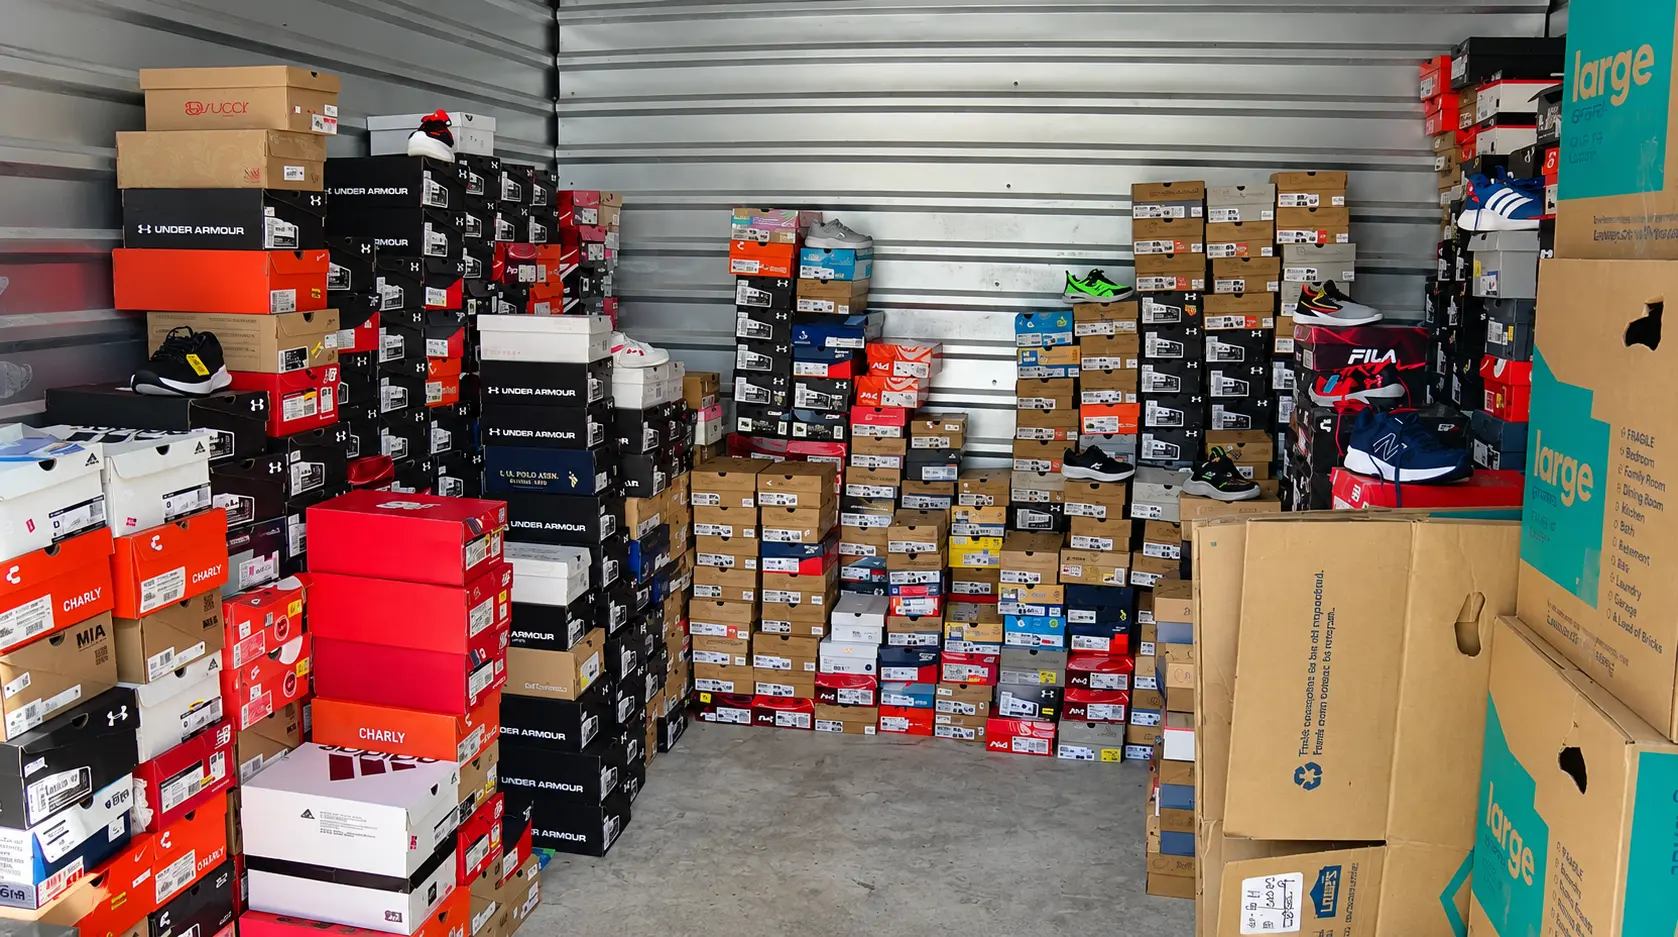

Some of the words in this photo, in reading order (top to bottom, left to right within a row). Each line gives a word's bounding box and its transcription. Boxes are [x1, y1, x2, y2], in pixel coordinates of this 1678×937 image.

[1572, 44, 1654, 106] large
[334, 187, 366, 195] UNDER
[367, 187, 409, 195] ARMOUR
[154, 225, 193, 235] UNDER
[194, 226, 245, 235] ARMOUR
[1348, 348, 1397, 364] FILA
[501, 387, 533, 396] UNDER
[534, 388, 576, 397] ARMOUR
[502, 429, 533, 438] UNDER
[535, 430, 576, 439] ARMOUR
[1627, 429, 1655, 449] FRAGILE
[516, 471, 536, 479] POLO
[1534, 429, 1594, 507] large
[510, 520, 542, 530] UNDER
[544, 522, 586, 532] ARMOUR
[192, 564, 222, 584] CHARLY
[63, 587, 102, 613] CHARLY
[76, 624, 106, 648] MIA
[511, 630, 555, 641] ARMOUR
[1642, 631, 1662, 654] Bricks
[359, 727, 405, 744] CHARLY
[522, 728, 566, 740] ARMOUR
[501, 776, 536, 788] UNDER
[538, 780, 583, 793] ARMOUR
[541, 830, 586, 843] ARMOUR
[1486, 780, 1535, 887] large
